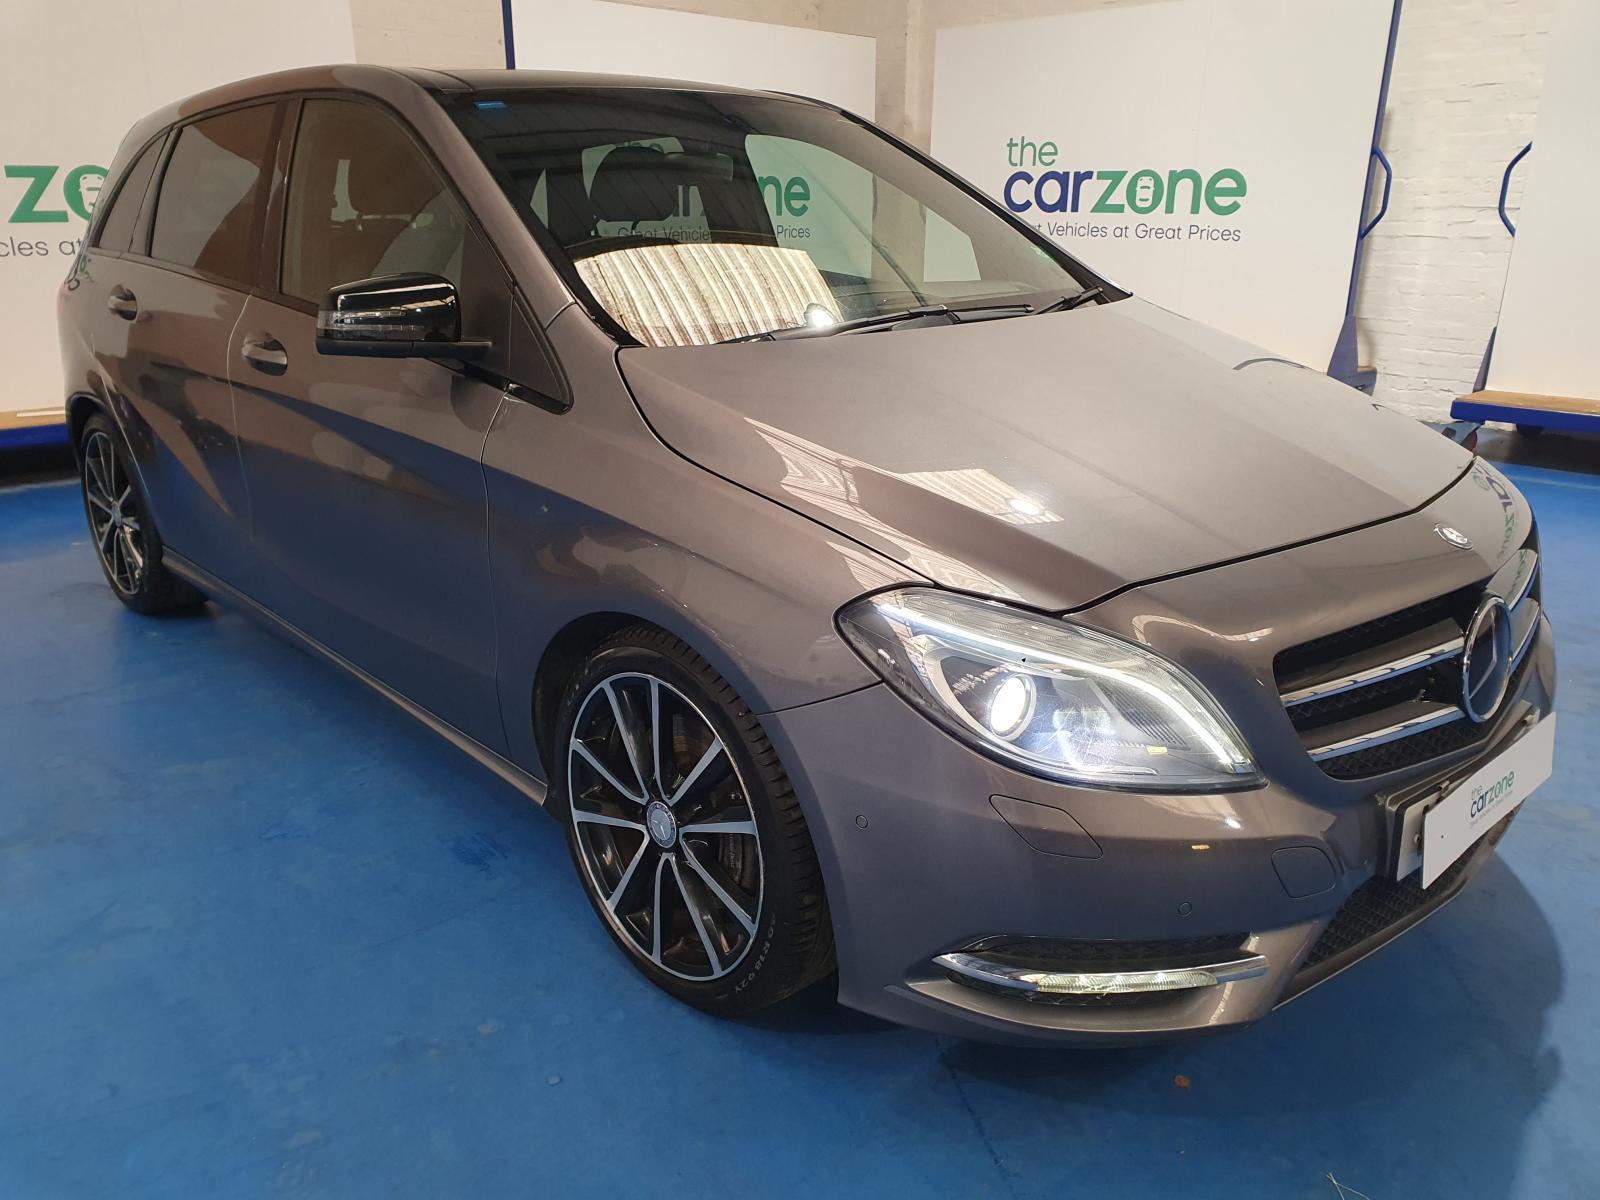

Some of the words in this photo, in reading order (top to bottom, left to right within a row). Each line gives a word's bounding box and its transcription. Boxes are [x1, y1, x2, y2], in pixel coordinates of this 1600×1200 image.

[1006, 136, 1058, 167] the
[1003, 168, 1248, 216] carzone
[776, 224, 811, 239] Prices
[1047, 222, 1108, 238] Vehicles
[1113, 224, 1129, 238] at
[1135, 223, 1182, 240] Great
[1188, 224, 1241, 242] Prices
[1470, 770, 1515, 818] carzone
